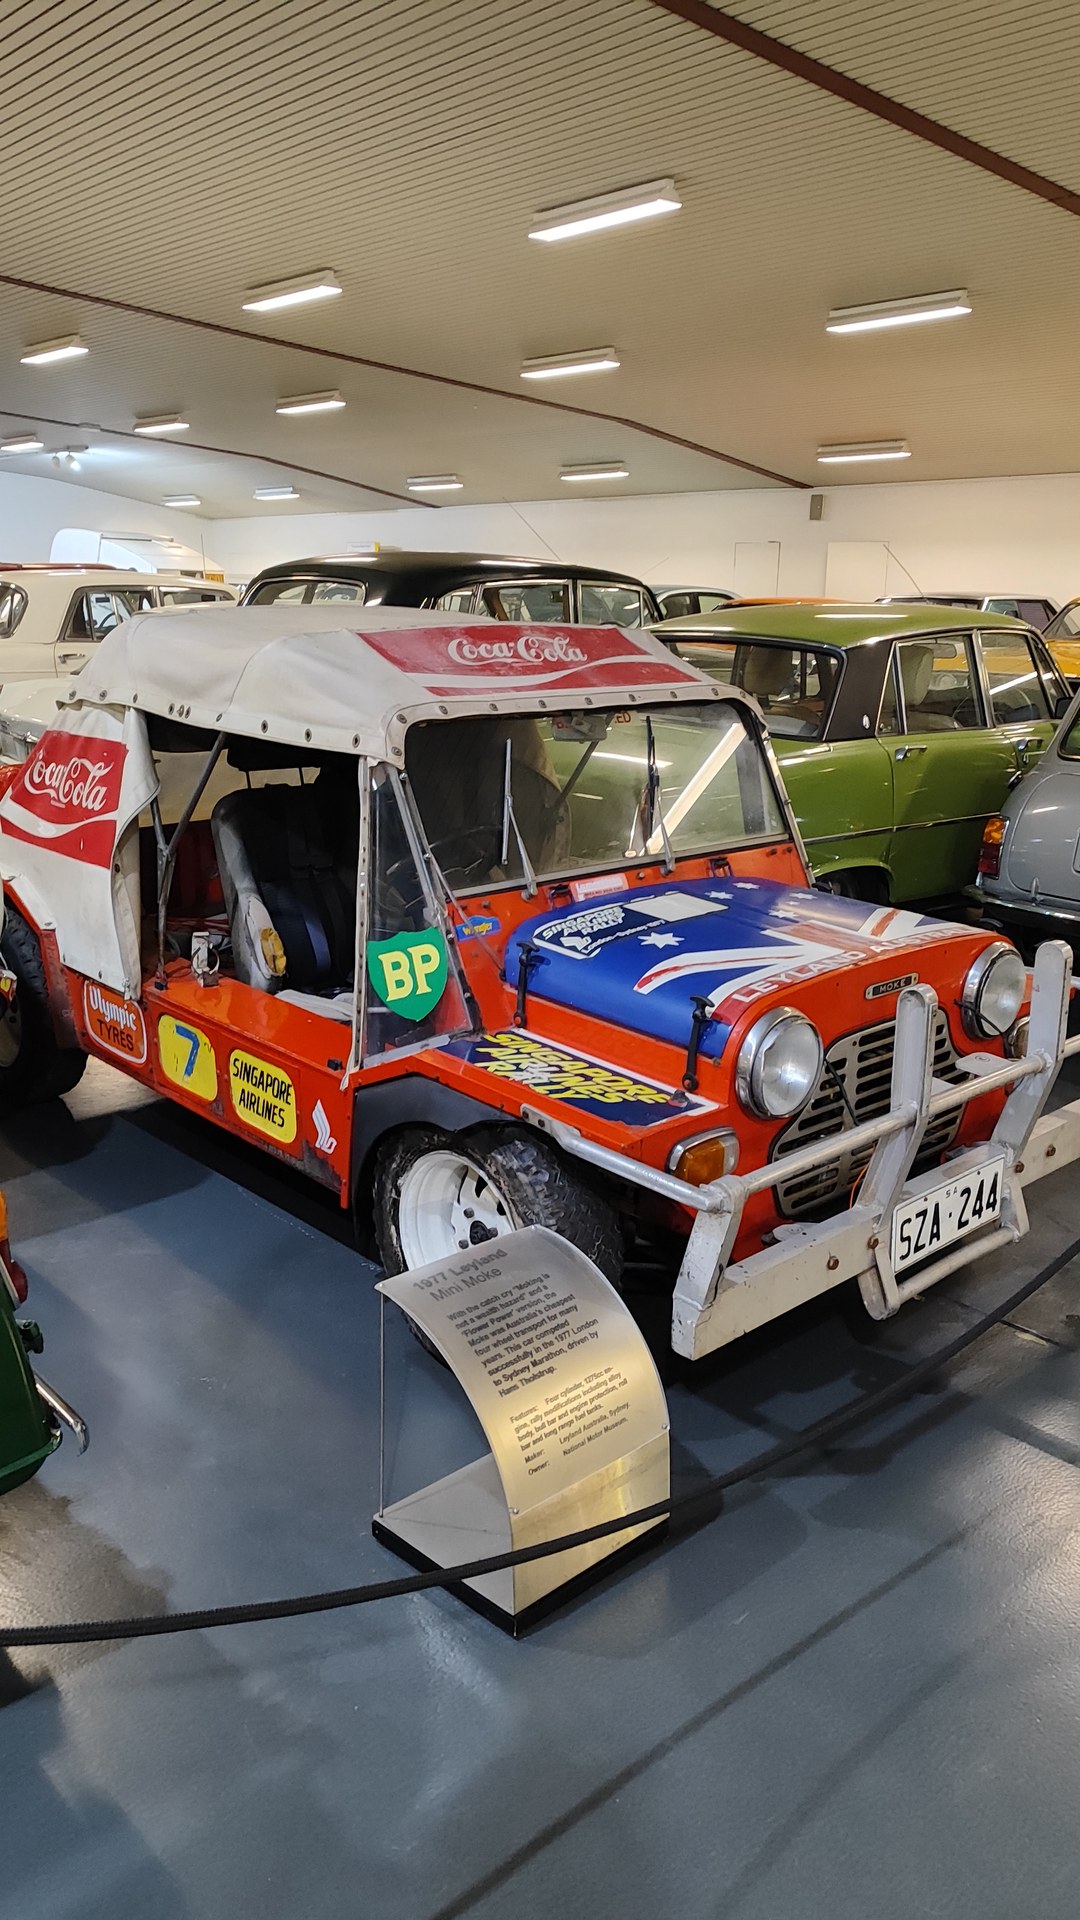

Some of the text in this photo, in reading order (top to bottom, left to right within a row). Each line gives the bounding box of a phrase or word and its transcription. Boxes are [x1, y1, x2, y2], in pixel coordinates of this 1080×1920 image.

[448, 636, 587, 665] Coca-Cola
[542, 906, 623, 940] SINGAPORE
[563, 912, 625, 936] AIRLINES
[581, 918, 623, 935] RALLY
[378, 944, 440, 1001] BP
[731, 951, 866, 1003] LEYLAND
[879, 978, 906, 993] MOKE
[89, 986, 137, 1031] Olympic
[97, 1019, 134, 1051] TYRES
[174, 1023, 200, 1078] 7
[232, 1058, 293, 1106] SINGAPORE
[474, 1061, 590, 1099] RALLY
[476, 1047, 623, 1104] AIRLINES
[482, 1034, 670, 1104] SINGAPORE
[239, 1088, 285, 1128] AIRLINES
[413, 1249, 508, 1290] 1977 Leyland
[430, 1268, 502, 1301] Mini Moke
[447, 1311, 466, 1321] With
[466, 1304, 480, 1314] the
[479, 1295, 500, 1307] catch
[501, 1290, 513, 1300] cry
[455, 1320, 469, 1330] not
[476, 1307, 500, 1320] wealth
[528, 1287, 543, 1297] and
[468, 1293, 576, 1347] Moke was Australia's cheapest
[515, 1298, 545, 1313] version,
[543, 1291, 557, 1301] the
[474, 1304, 578, 1356] four wheel transport for many
[481, 1320, 570, 1368] years. This car competed
[487, 1318, 599, 1376] successfully in the 1977 London
[493, 1330, 599, 1387] to Sydney Marathon, driven by
[498, 1366, 557, 1397] Hans Tholstrup.
[510, 1405, 539, 1423] Features:
[545, 1395, 560, 1405] Four
[560, 1382, 584, 1398] cylinder,
[584, 1370, 604, 1384] 1275cc
[517, 1377, 628, 1442] body, bull bar and engine protection, roll
[530, 1414, 543, 1425] rally
[543, 1393, 582, 1417] modifications
[582, 1379, 608, 1396] including
[608, 1372, 622, 1384] alloy
[521, 1403, 603, 1451] bar and long range fuel tanks.
[525, 1448, 545, 1463] Maker:
[559, 1427, 582, 1444] Leyland
[583, 1414, 609, 1432] Australia,
[528, 1417, 628, 1475] Owner: National Motor Museum.
